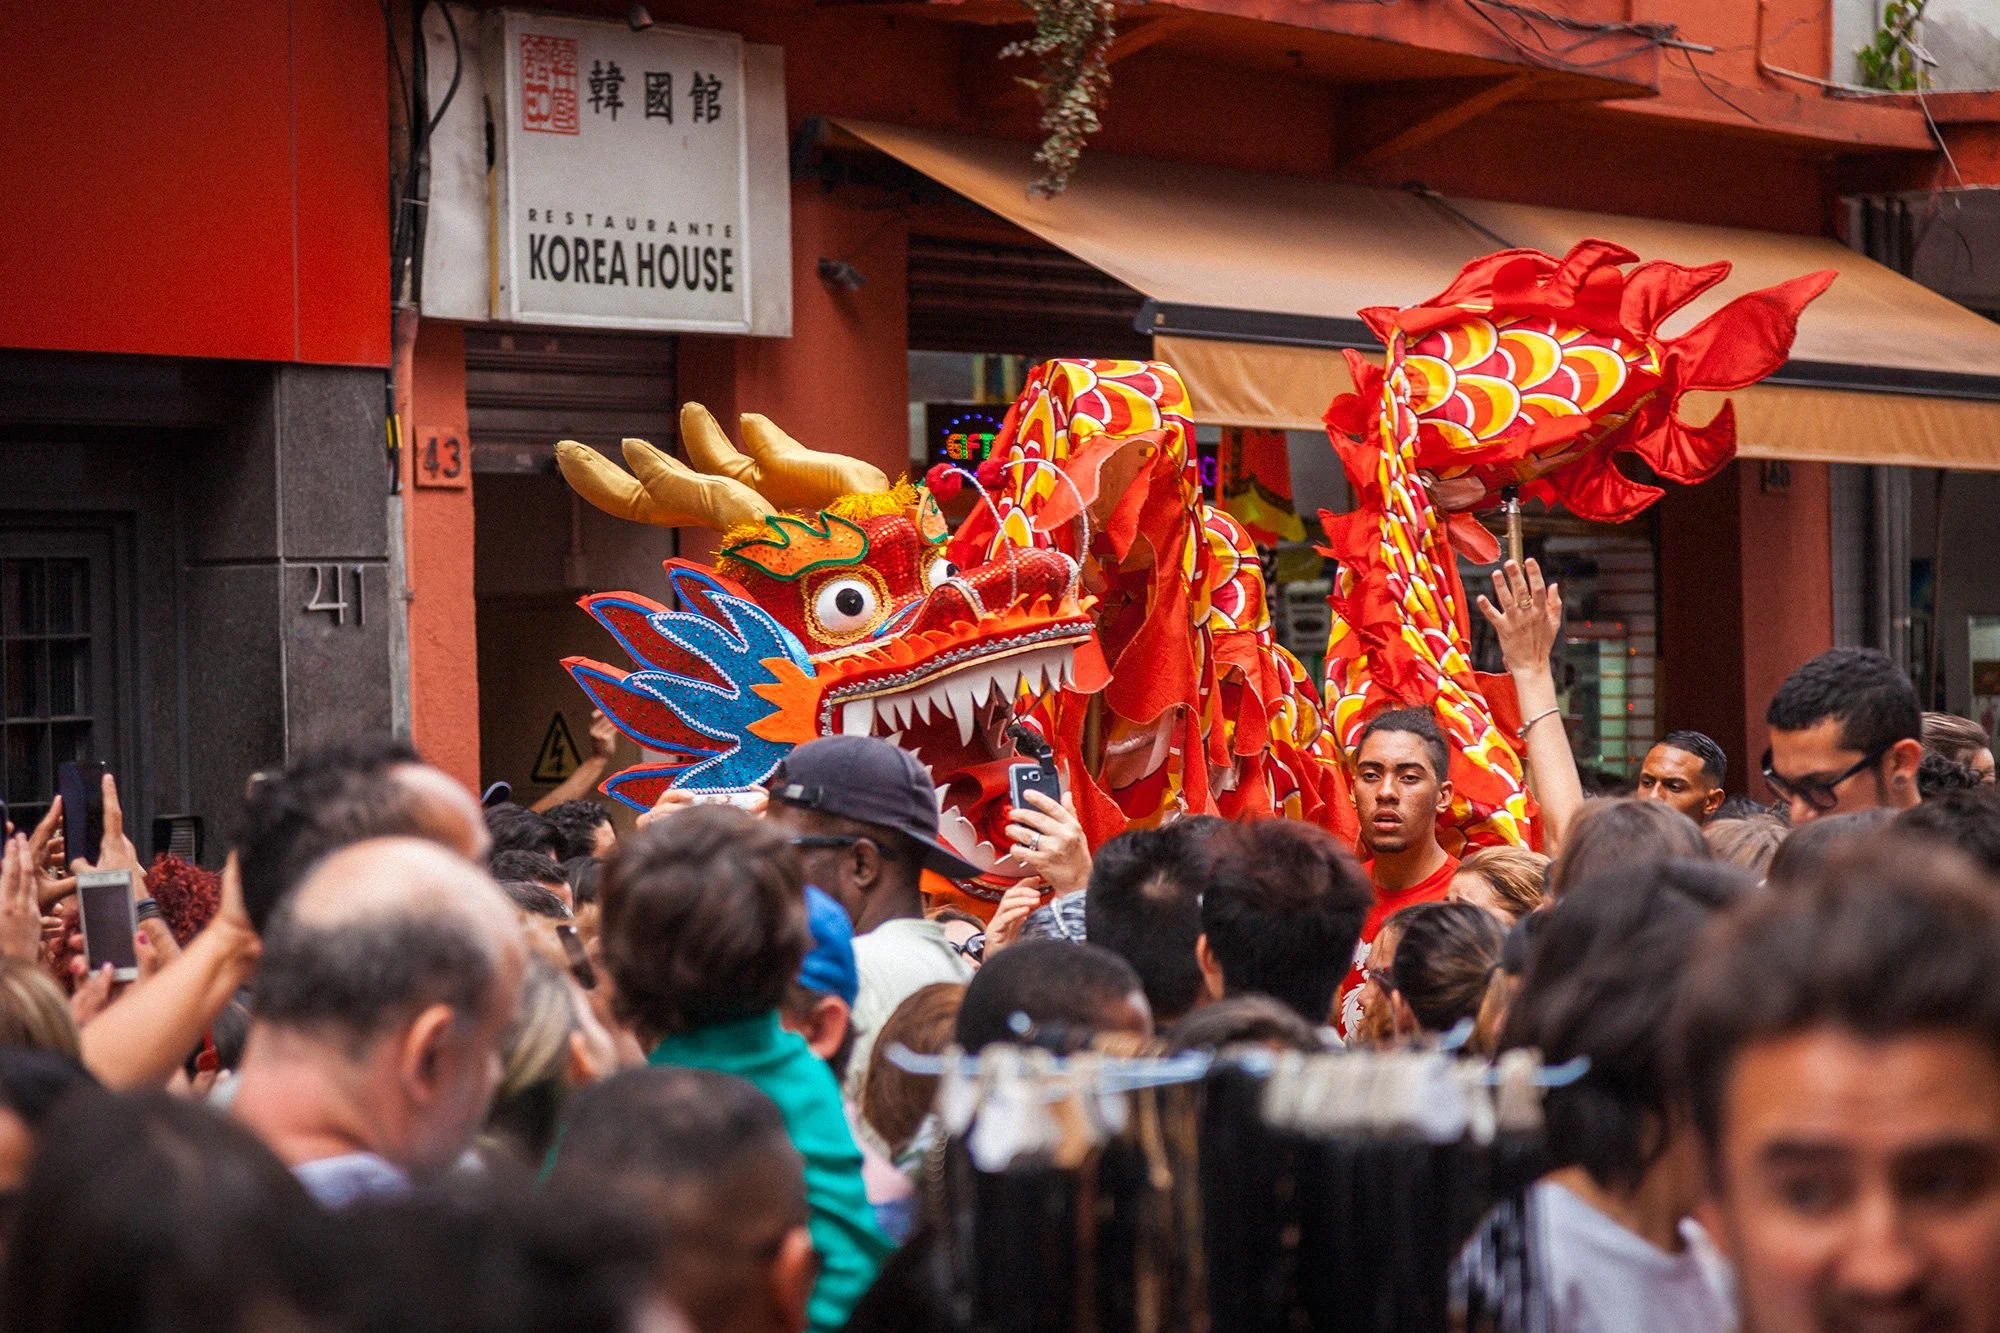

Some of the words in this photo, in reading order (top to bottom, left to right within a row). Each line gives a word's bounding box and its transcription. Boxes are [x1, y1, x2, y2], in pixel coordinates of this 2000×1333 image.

[587, 60, 723, 124] 韓國館
[528, 208, 733, 239] RESTAURANTE
[529, 233, 628, 286] KOREA
[637, 242, 734, 293] HOUSE
[424, 437, 462, 478] 43
[306, 565, 364, 625] 41
